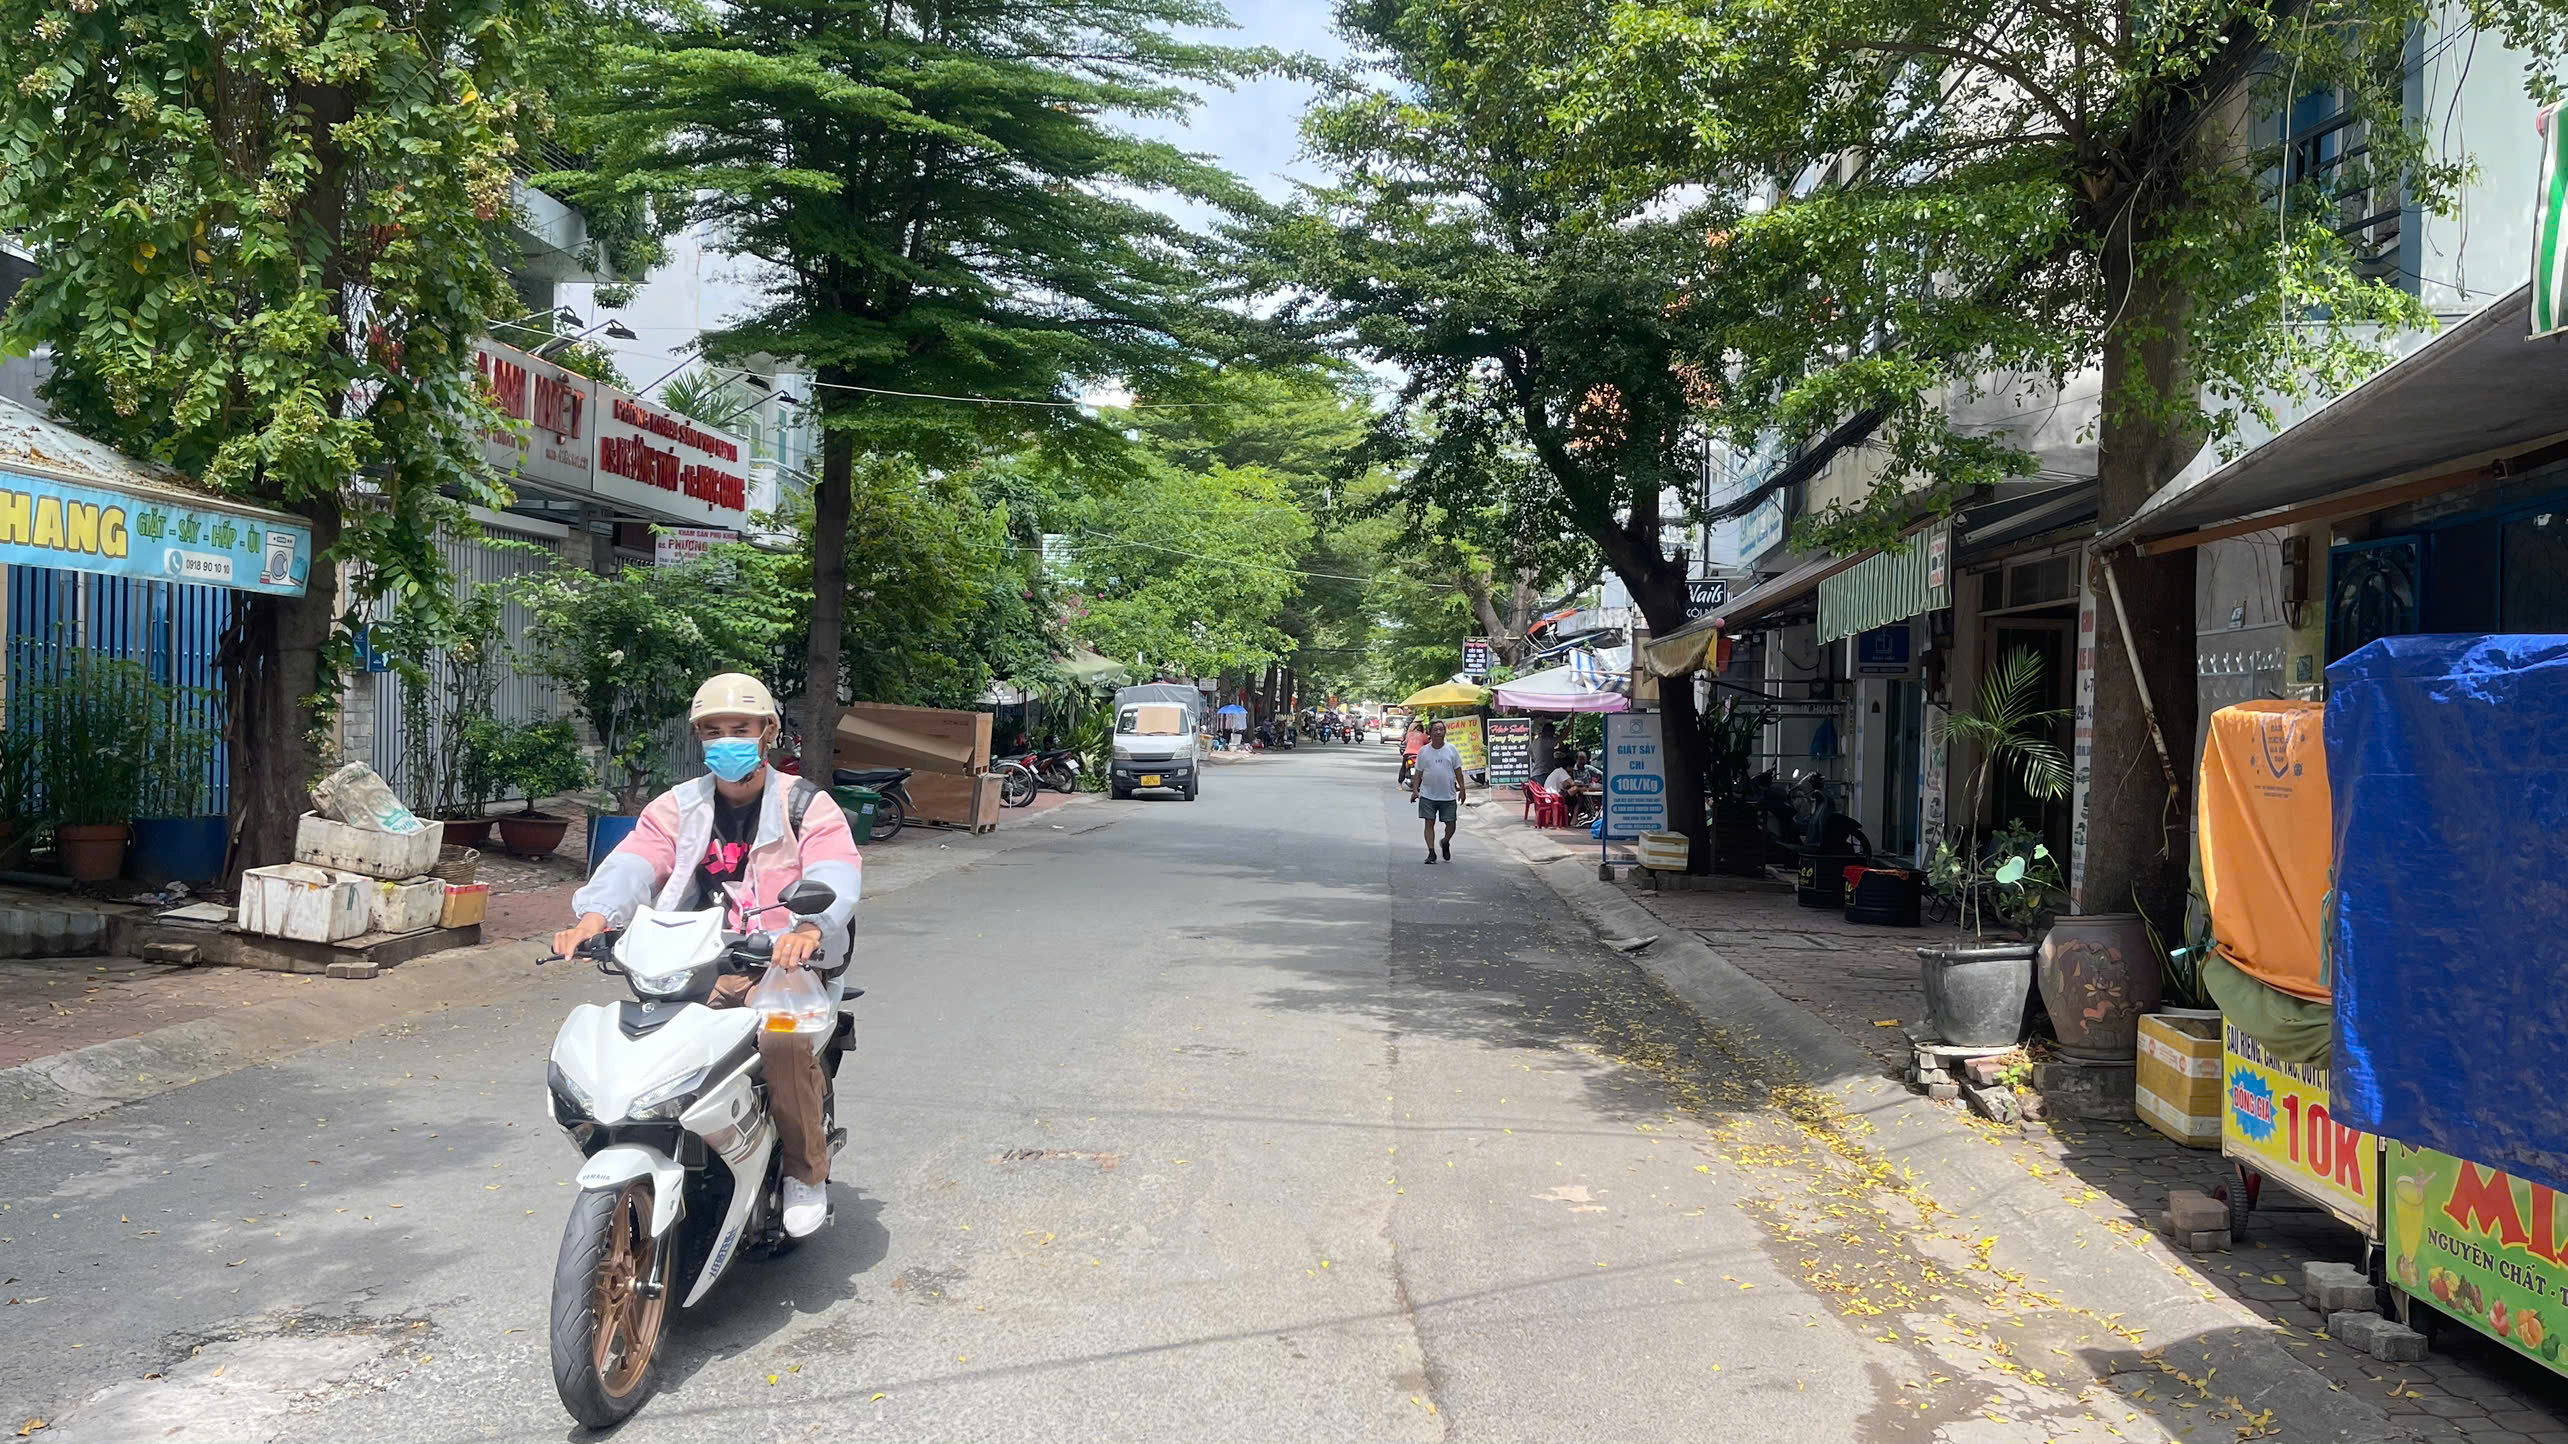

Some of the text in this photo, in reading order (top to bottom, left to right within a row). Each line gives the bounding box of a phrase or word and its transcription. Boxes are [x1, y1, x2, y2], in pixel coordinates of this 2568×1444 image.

[136, 508, 166, 543] GIẶT
[178, 518, 201, 543] SẤY
[211, 523, 237, 549] HẤP
[186, 559, 201, 571] 0918
[202, 562, 213, 573] 90
[214, 563, 222, 574] 10
[1616, 778, 1658, 792] 10K/Kg
[2282, 1094, 2364, 1196] 10K
[2427, 1227, 2547, 1296] NGUYÊN CHẤT
